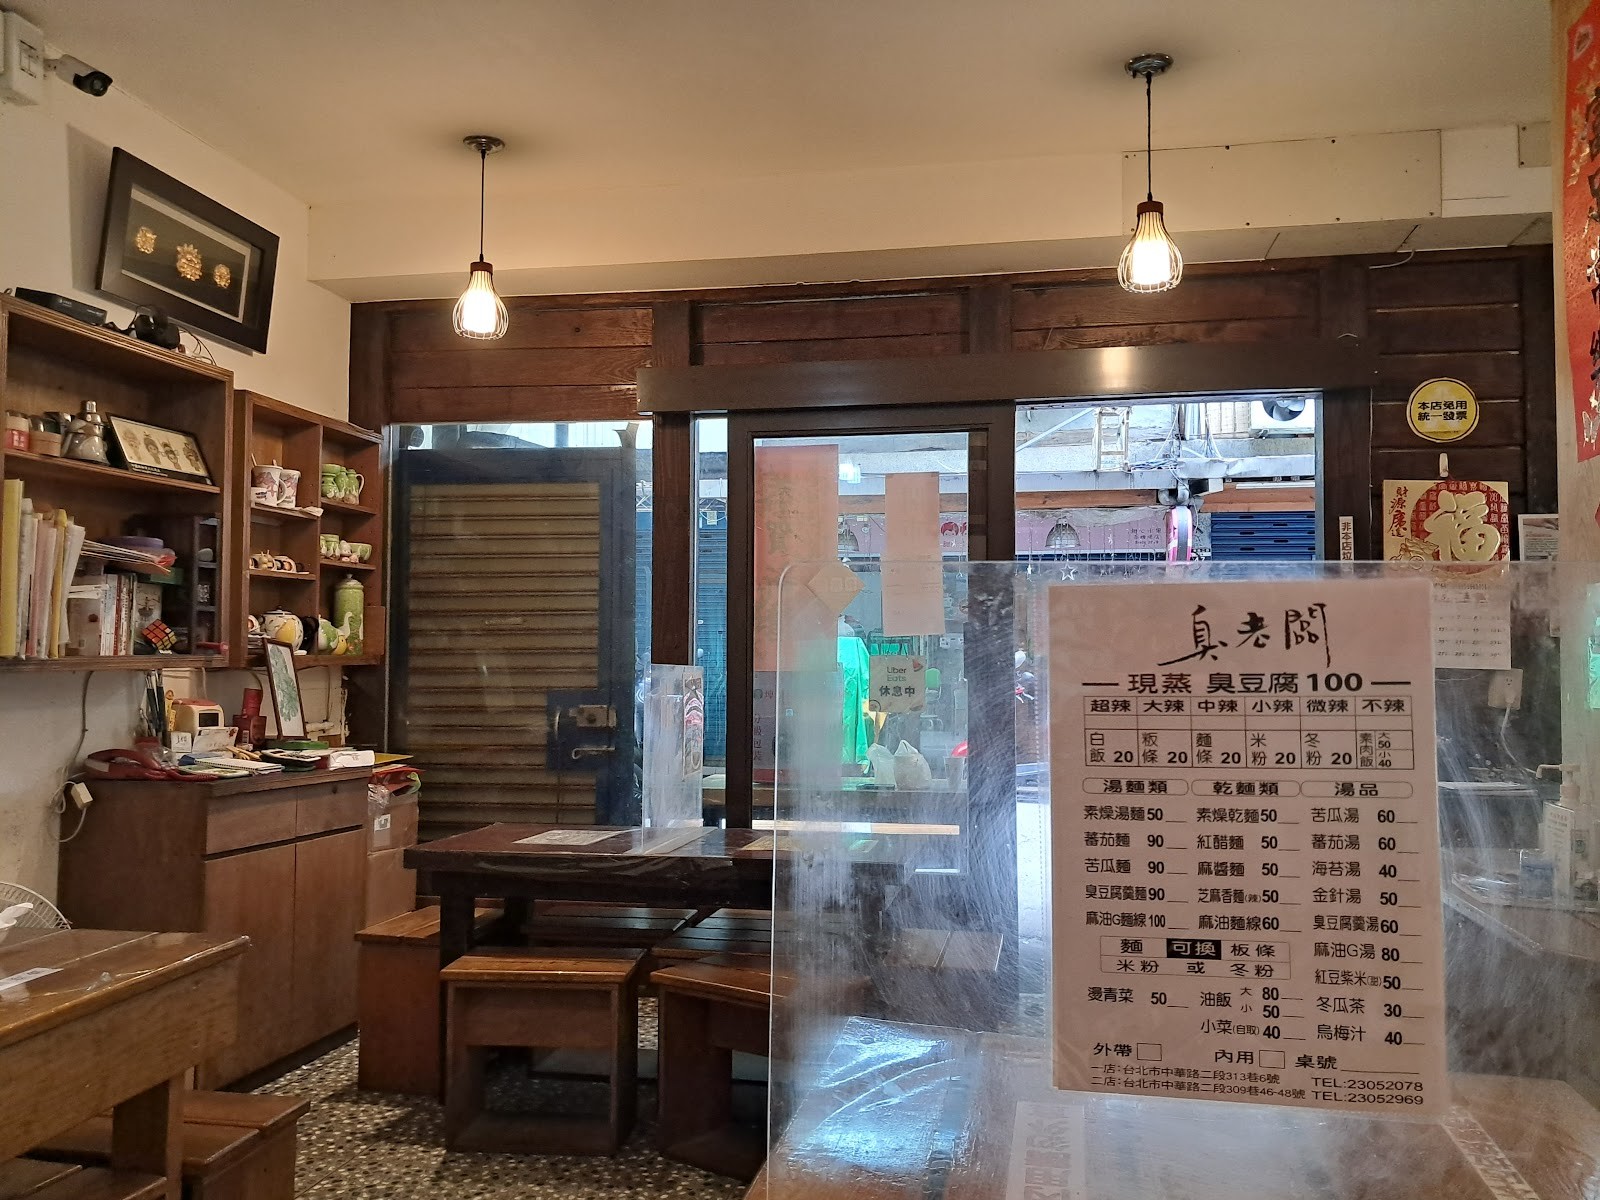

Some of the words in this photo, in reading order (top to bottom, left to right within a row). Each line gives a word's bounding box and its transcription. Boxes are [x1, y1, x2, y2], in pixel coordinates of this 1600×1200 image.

[1417, 400, 1468, 411] 本店免用
[1417, 411, 1468, 422] 統一發票
[1424, 490, 1501, 561] 福
[886, 666, 907, 674] Uber
[1128, 673, 1192, 694] 現蒸
[1207, 672, 1298, 694] 臭豆腐
[1306, 673, 1363, 692] 100
[879, 685, 915, 697] 休息中
[1090, 699, 1131, 713] 超辣
[1143, 699, 1185, 713] 大辣
[1197, 699, 1238, 713] 中辣
[1252, 699, 1294, 713] 小辣
[1306, 699, 1349, 713] 微辣
[1362, 699, 1405, 713] 不辣
[1377, 732, 1390, 740] 大
[1359, 732, 1374, 767] 素肉飯
[1378, 740, 1391, 749] 50
[1113, 751, 1134, 763] 20
[1167, 751, 1188, 764] 20
[1221, 752, 1241, 764] 20
[1275, 752, 1296, 765] 20
[1331, 752, 1352, 765] 20
[1378, 759, 1392, 768] 40
[1103, 779, 1168, 794] 湯麵類
[1213, 781, 1279, 796] 乾麵類
[1334, 782, 1379, 796] 湯品
[1147, 808, 1163, 821] 50
[1260, 809, 1277, 822] 50
[1310, 807, 1359, 823] 苦瓜湯
[1377, 810, 1395, 823] 60
[1084, 831, 1130, 848] 蕃茄麵
[1147, 834, 1164, 848] 90
[1197, 834, 1244, 850] 紅醋麵
[1261, 836, 1278, 849] 50
[1311, 834, 1360, 850] 蕃茄湯
[1378, 837, 1396, 851] 60
[1084, 858, 1131, 874] 苦瓜麵
[1148, 861, 1165, 874] 90
[1197, 861, 1245, 877] 麻醬麵
[1261, 863, 1279, 877] 50
[1312, 860, 1361, 877] 海苔湯
[1379, 864, 1397, 878] 40
[1085, 884, 1147, 901] 臭豆腐羹麵
[1148, 888, 1165, 901] 90
[1262, 890, 1279, 903] 50
[1312, 887, 1362, 904] 金針湯
[1380, 892, 1398, 906] 50
[1086, 911, 1147, 928] 麻油G麵線
[1149, 914, 1166, 928] 100
[1198, 915, 1262, 932] 麻油麵線
[1262, 917, 1280, 931] 60
[1313, 914, 1379, 932] 臭豆腐羹湯
[1380, 919, 1399, 934] 60
[1120, 939, 1143, 954] 麵
[1171, 941, 1216, 956] 可換
[1231, 944, 1276, 958] 板條
[1313, 942, 1375, 960] 麻油G湯
[1381, 947, 1400, 961] 80
[1117, 959, 1159, 973] 米粉
[1187, 961, 1206, 974] 或
[1230, 963, 1274, 978] 冬粉
[1383, 975, 1401, 990] 50
[1088, 986, 1134, 1003] 燙青菜
[1150, 992, 1167, 1005] 50
[1200, 992, 1232, 1008] 油飯
[1240, 987, 1253, 997] 大
[1262, 987, 1279, 1001] 80
[1240, 1004, 1253, 1013] 小
[1262, 1005, 1280, 1019] 50
[1316, 996, 1365, 1014] 冬瓜茶
[1384, 1003, 1402, 1017] 30
[1263, 1025, 1281, 1040] 40
[1317, 1024, 1366, 1042] 烏梅汁
[1384, 1032, 1403, 1046] 40
[1093, 1042, 1132, 1057] 外帶
[1295, 1054, 1338, 1070] 桌號
[1311, 1077, 1424, 1092] TEL:23052078
[1311, 1090, 1424, 1105] TEL:23052969
